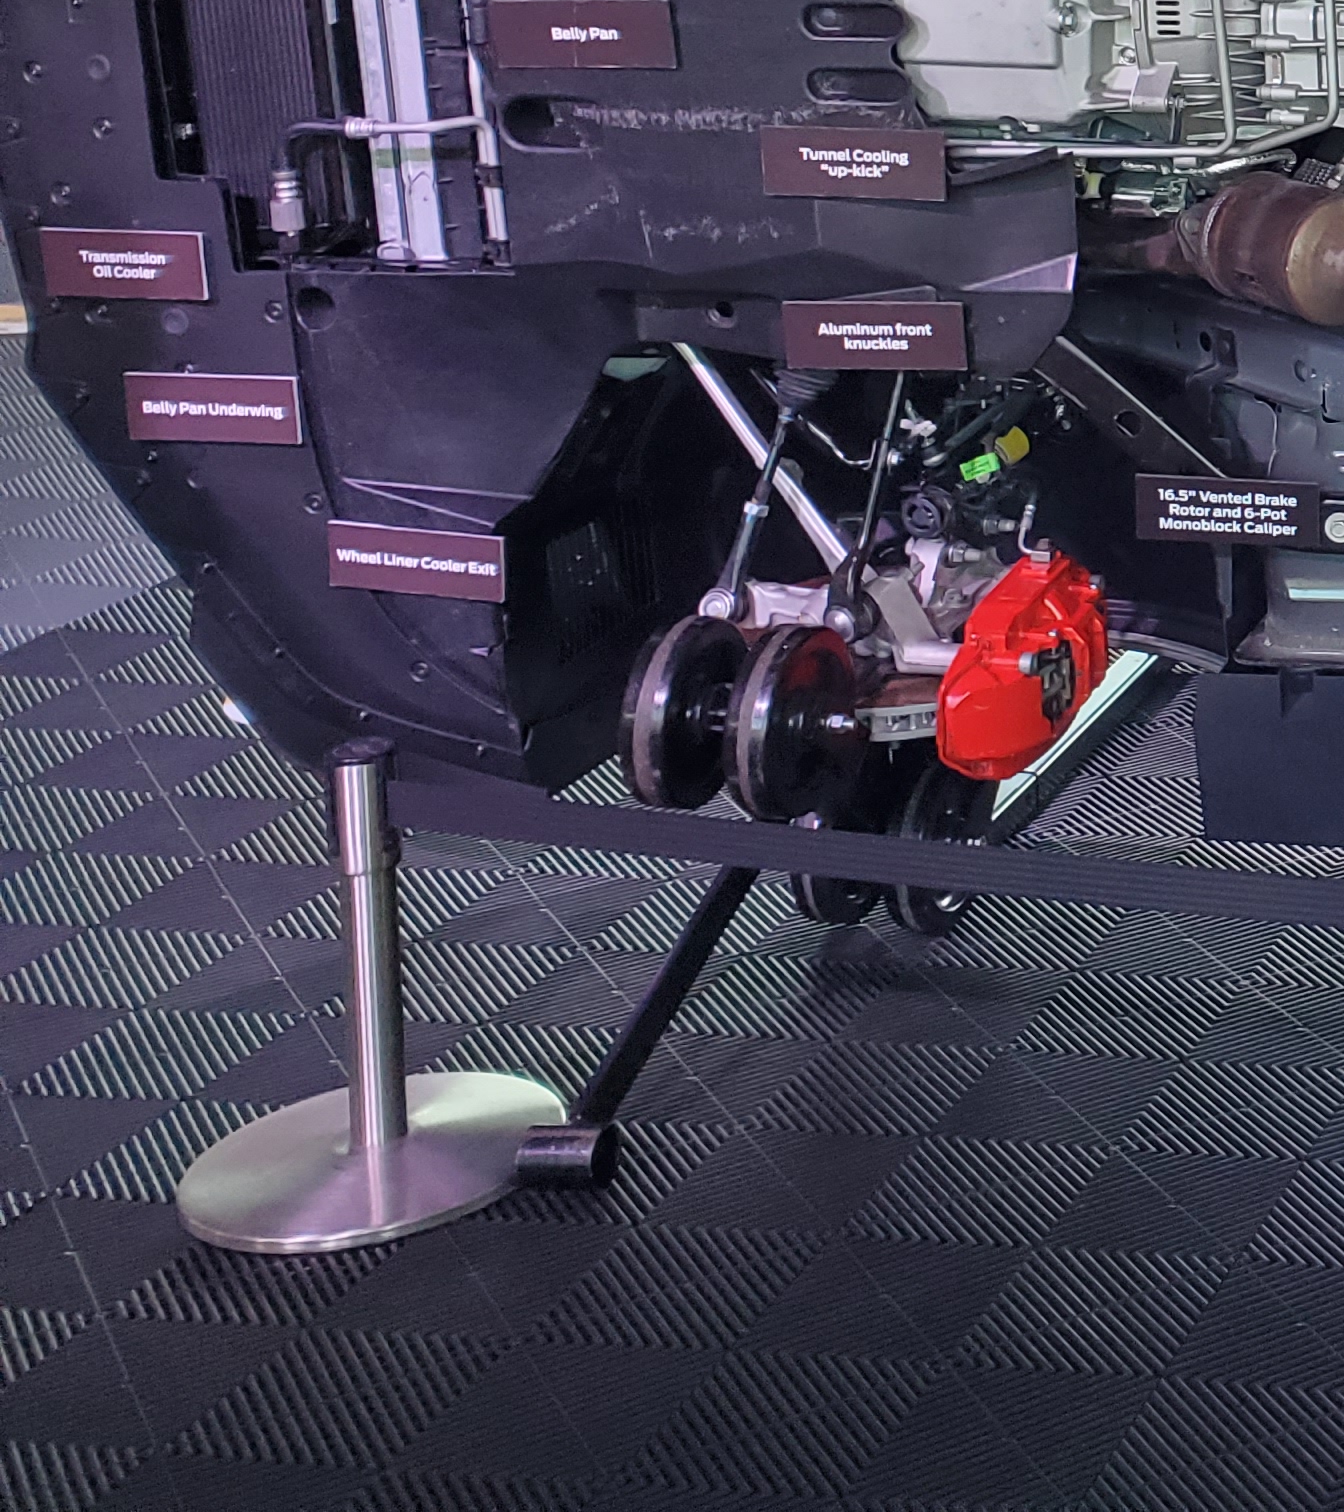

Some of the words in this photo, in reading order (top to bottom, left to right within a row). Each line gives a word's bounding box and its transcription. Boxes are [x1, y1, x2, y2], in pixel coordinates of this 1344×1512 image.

[551, 27, 587, 42] Belly
[589, 27, 618, 40] Pan
[799, 148, 851, 161] Tunnel
[853, 149, 909, 166] Cooling
[79, 250, 168, 264] Transmission
[93, 265, 112, 277] Oil
[114, 266, 158, 279] Cooler
[818, 323, 893, 335] Aluminum
[895, 323, 932, 336] front
[844, 337, 908, 350] knuckles
[143, 401, 177, 416] Belly
[179, 402, 206, 415] Pan
[208, 403, 284, 420] Underwing
[1199, 491, 1252, 504] Vented
[1255, 494, 1297, 507] Brake
[1169, 504, 1210, 516] Rotor
[1213, 507, 1241, 518] and
[1244, 508, 1287, 520] 6-Pot
[1159, 517, 1241, 532] Monoblock
[1244, 522, 1297, 536] Caliper
[336, 549, 382, 564] Wheel
[384, 553, 420, 568] Liner
[421, 557, 468, 572] Cooler
[468, 562, 497, 576] Exit
